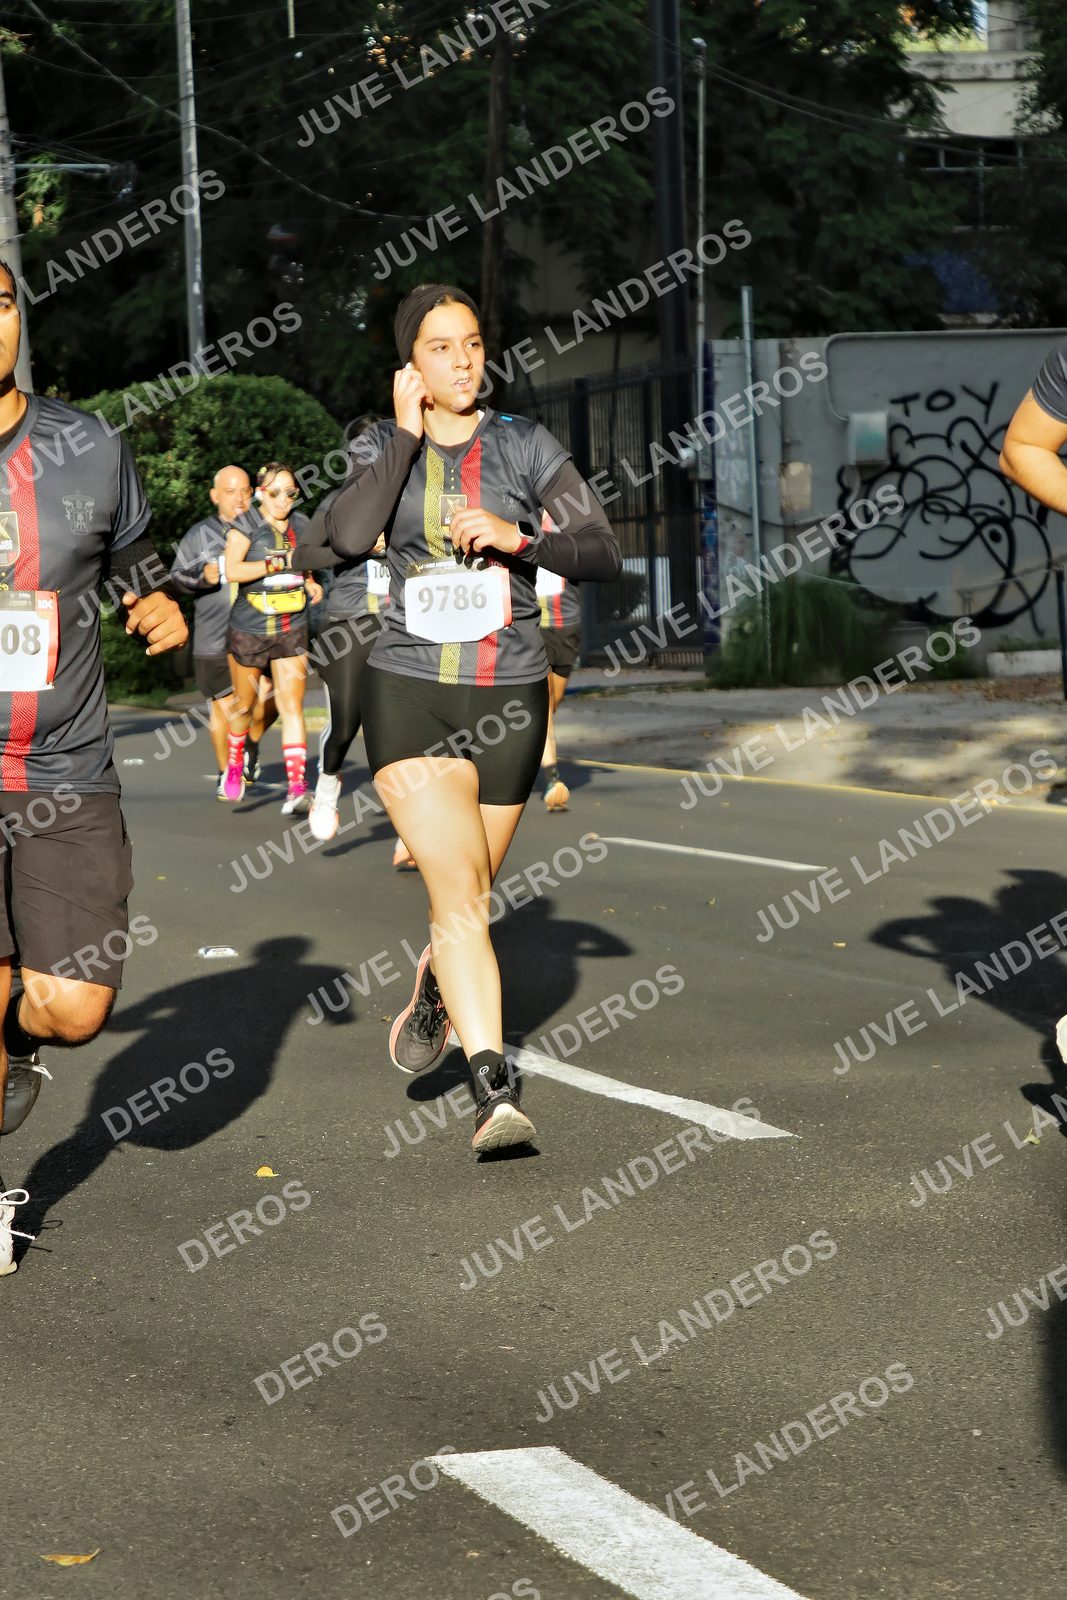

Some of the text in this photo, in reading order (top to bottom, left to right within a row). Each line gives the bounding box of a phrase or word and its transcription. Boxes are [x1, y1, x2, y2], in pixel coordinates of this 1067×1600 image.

[889, 381, 998, 425] TOY
[418, 583, 487, 614] 9786
[1, 624, 41, 655] 08
